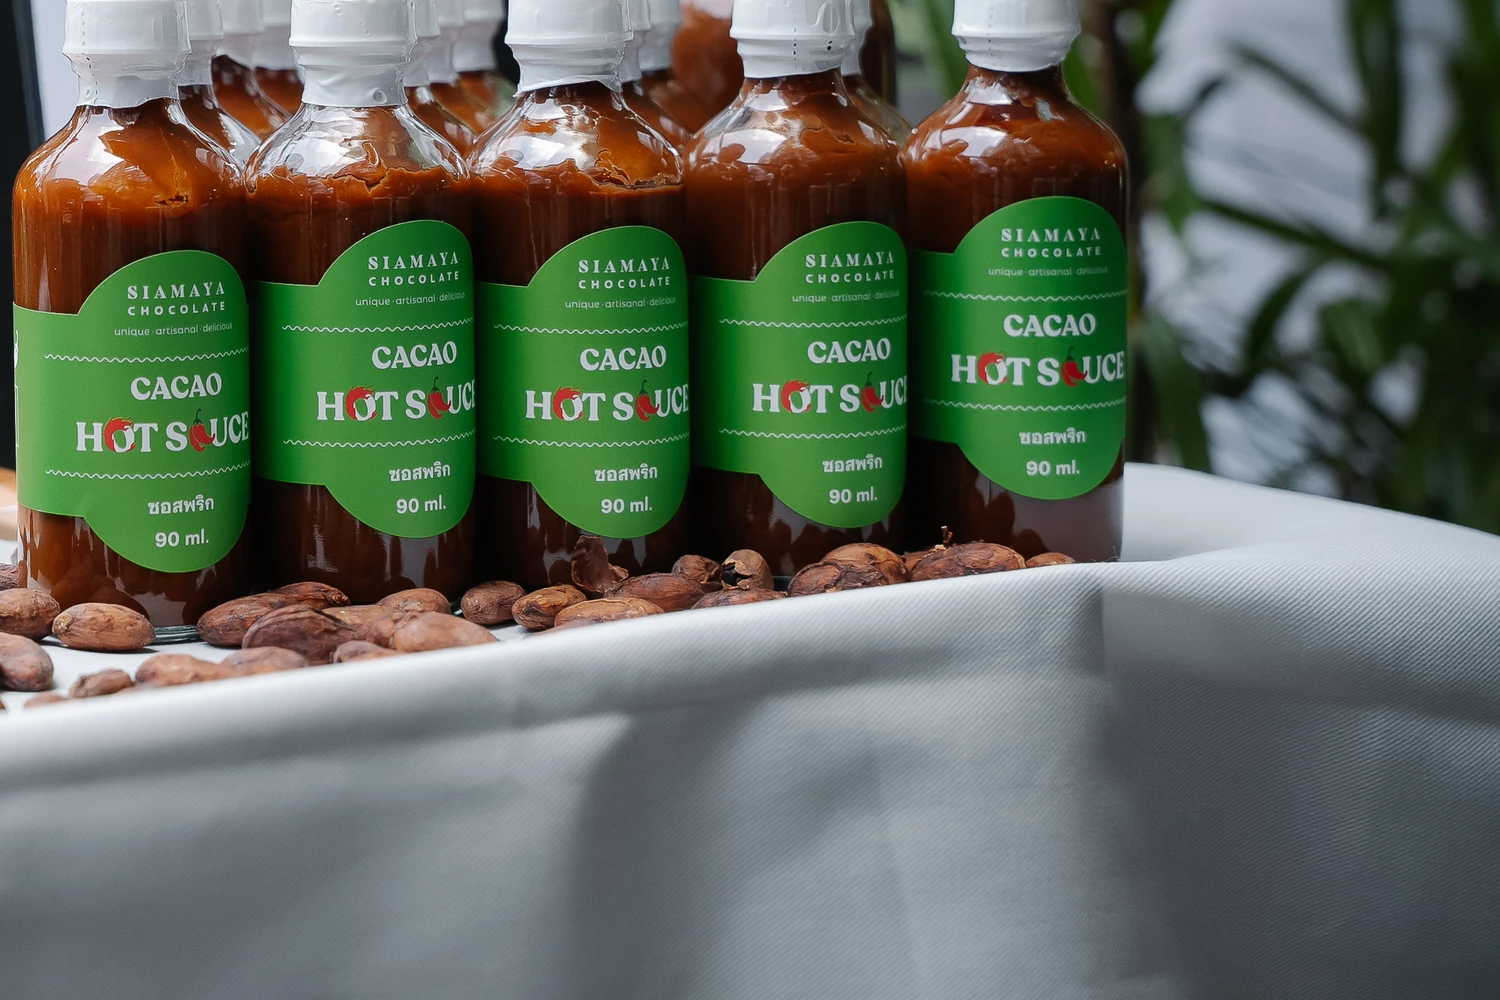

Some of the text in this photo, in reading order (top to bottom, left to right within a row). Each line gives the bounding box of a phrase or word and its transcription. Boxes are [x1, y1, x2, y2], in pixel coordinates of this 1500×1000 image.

[1001, 228, 1100, 242] SIAMAYA
[368, 251, 459, 270] SIAMAYA
[805, 252, 894, 267] SIAMAYA
[1001, 246, 1100, 258] CHOCOLATE
[578, 257, 670, 273] SIAMAYA
[988, 267, 1023, 277] unique
[1028, 267, 1072, 276] artisanal
[368, 271, 459, 286] CHOCOLATE
[578, 276, 670, 289] CHOCOLATE
[805, 270, 894, 284] CHOCOLATE
[127, 282, 225, 299] SIAMAYA
[355, 291, 465, 307] unique artisanal delicious
[792, 294, 827, 304] unique
[831, 292, 870, 302] artisanal
[128, 301, 225, 316] CHOCOLATE
[565, 300, 600, 310] unique
[605, 298, 646, 308] artisanal
[114, 321, 233, 337] unique artisanal delicious
[1003, 313, 1096, 337] CACAO
[371, 341, 457, 370] CACAO
[580, 345, 667, 371] CACAO
[807, 338, 891, 364] CACAO
[951, 346, 1124, 387] HOT SAUCE
[130, 372, 222, 400] CACAO
[316, 385, 398, 421] HOT
[525, 379, 688, 422] HOT SAUCE
[752, 379, 833, 413] HOT
[76, 409, 249, 452] HOT SAUCE
[1019, 427, 1086, 445] ซอสพริก
[389, 461, 450, 482] ซอสพริก
[822, 453, 882, 473] ซอสพริก
[1026, 460, 1080, 476] 90 ml.
[594, 463, 658, 482] ซอสพริก
[829, 486, 878, 504] 90 ml.
[147, 494, 214, 515] ซอสพริก
[396, 495, 446, 514] 90 ml.
[601, 496, 652, 513] 90 ml.
[155, 529, 209, 548] 90 ml.
